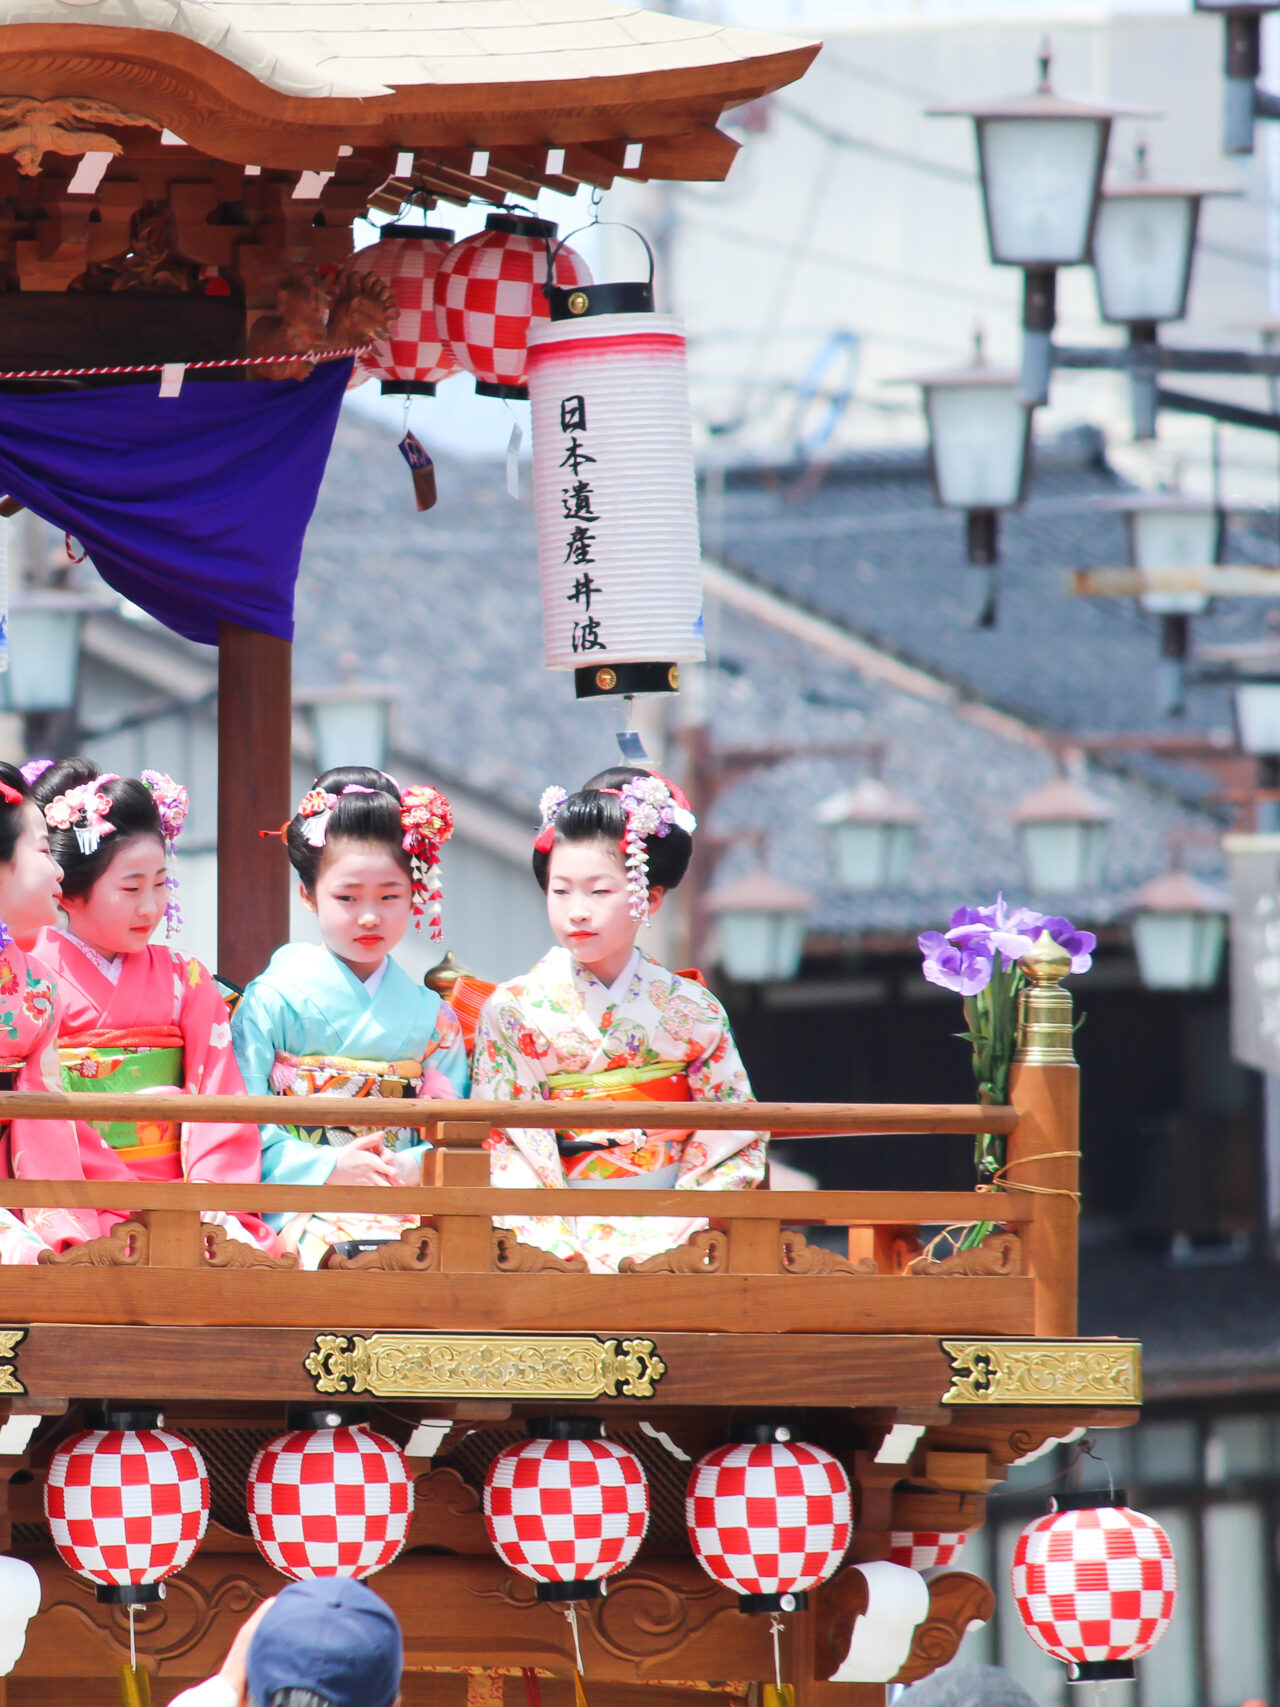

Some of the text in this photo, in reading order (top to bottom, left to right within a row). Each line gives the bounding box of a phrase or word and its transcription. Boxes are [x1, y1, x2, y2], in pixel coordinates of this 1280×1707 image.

[559, 395, 607, 652] 日本遺産井波
